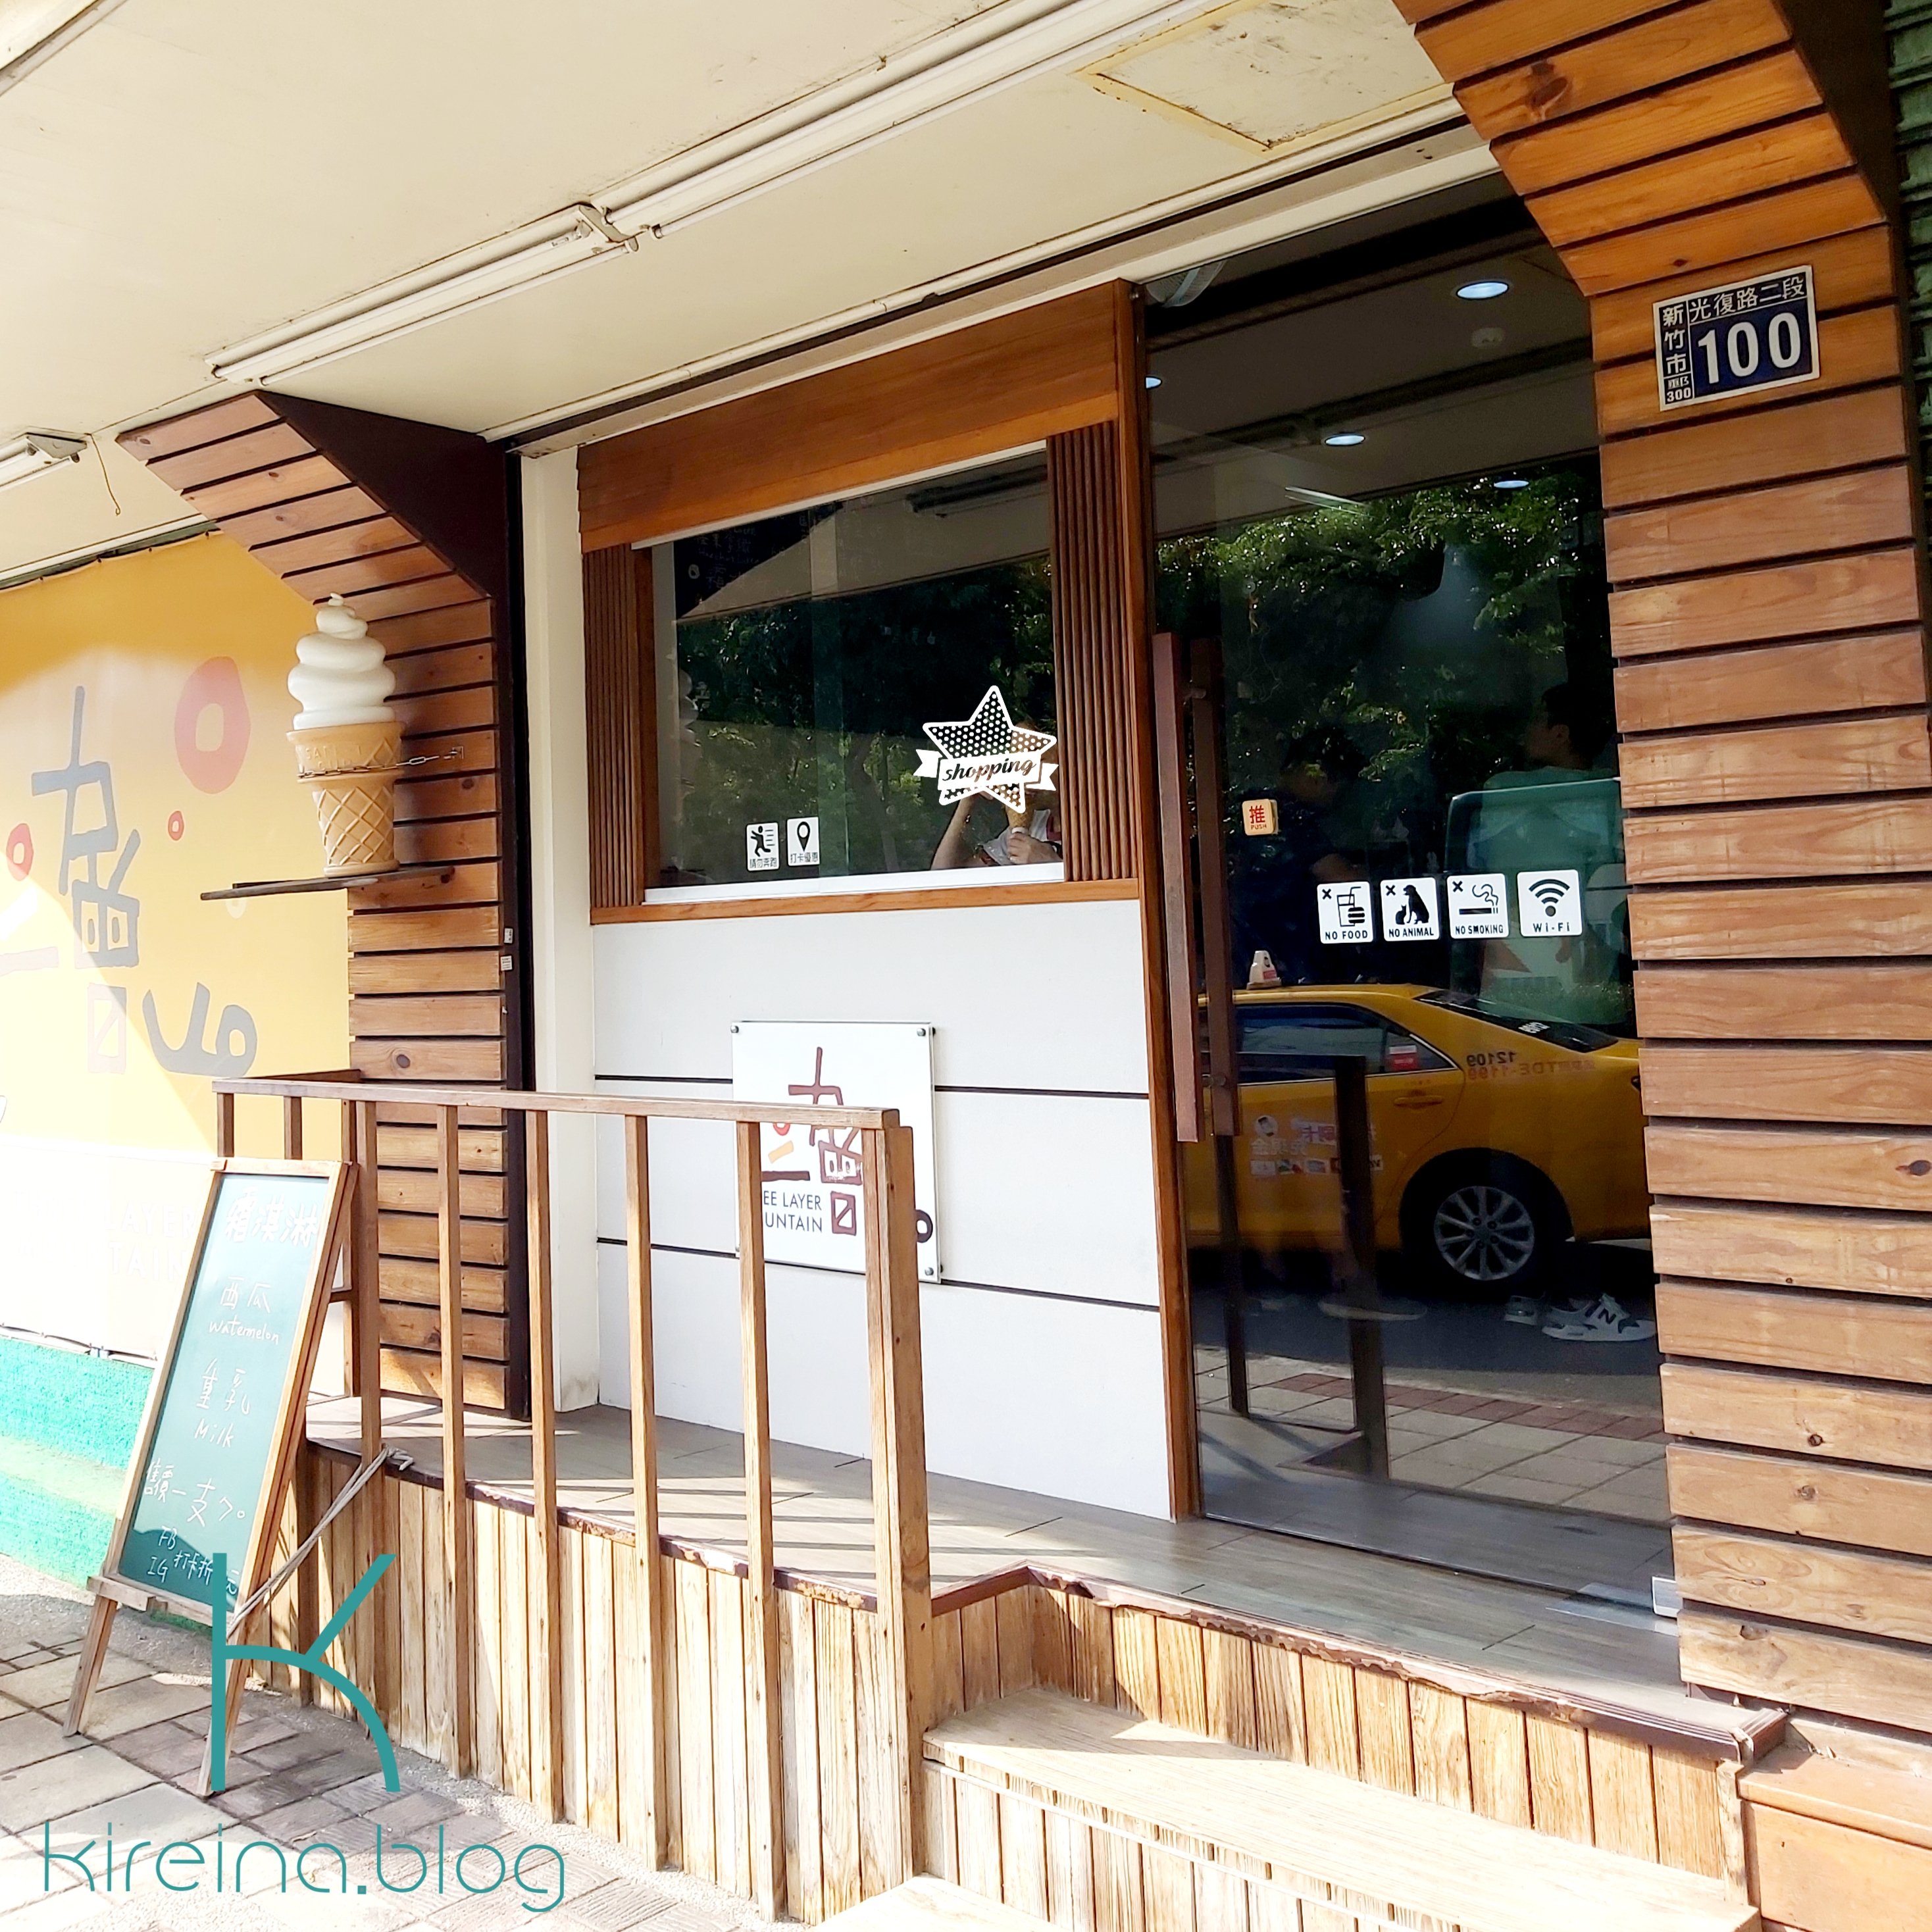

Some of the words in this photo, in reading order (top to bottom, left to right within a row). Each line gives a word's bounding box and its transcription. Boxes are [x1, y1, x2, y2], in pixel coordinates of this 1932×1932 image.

[1689, 276, 1805, 322] 光復路二段
[1662, 303, 1687, 374] 新竹市
[1698, 312, 1801, 384] 100
[1666, 387, 1691, 402] 300
[942, 757, 1037, 782] shopping
[1249, 805, 1265, 824] 推
[790, 852, 819, 864] 打卡優惠
[1325, 931, 1338, 940] NO
[1342, 930, 1369, 940] FOOD
[1388, 928, 1400, 938] NO
[1402, 927, 1435, 937] ANIMAL
[1455, 926, 1466, 935] NO
[1467, 925, 1504, 935] SMOKING
[1533, 923, 1571, 933] Wi-Fi
[783, 1192, 822, 1211] LAYER
[765, 1211, 823, 1233] UNTAIN
[220, 1275, 272, 1313] 西瓜
[209, 1315, 280, 1344] watermelon
[193, 1418, 234, 1448] Milk
[158, 1525, 178, 1550] FB
[147, 1556, 168, 1583] IG
